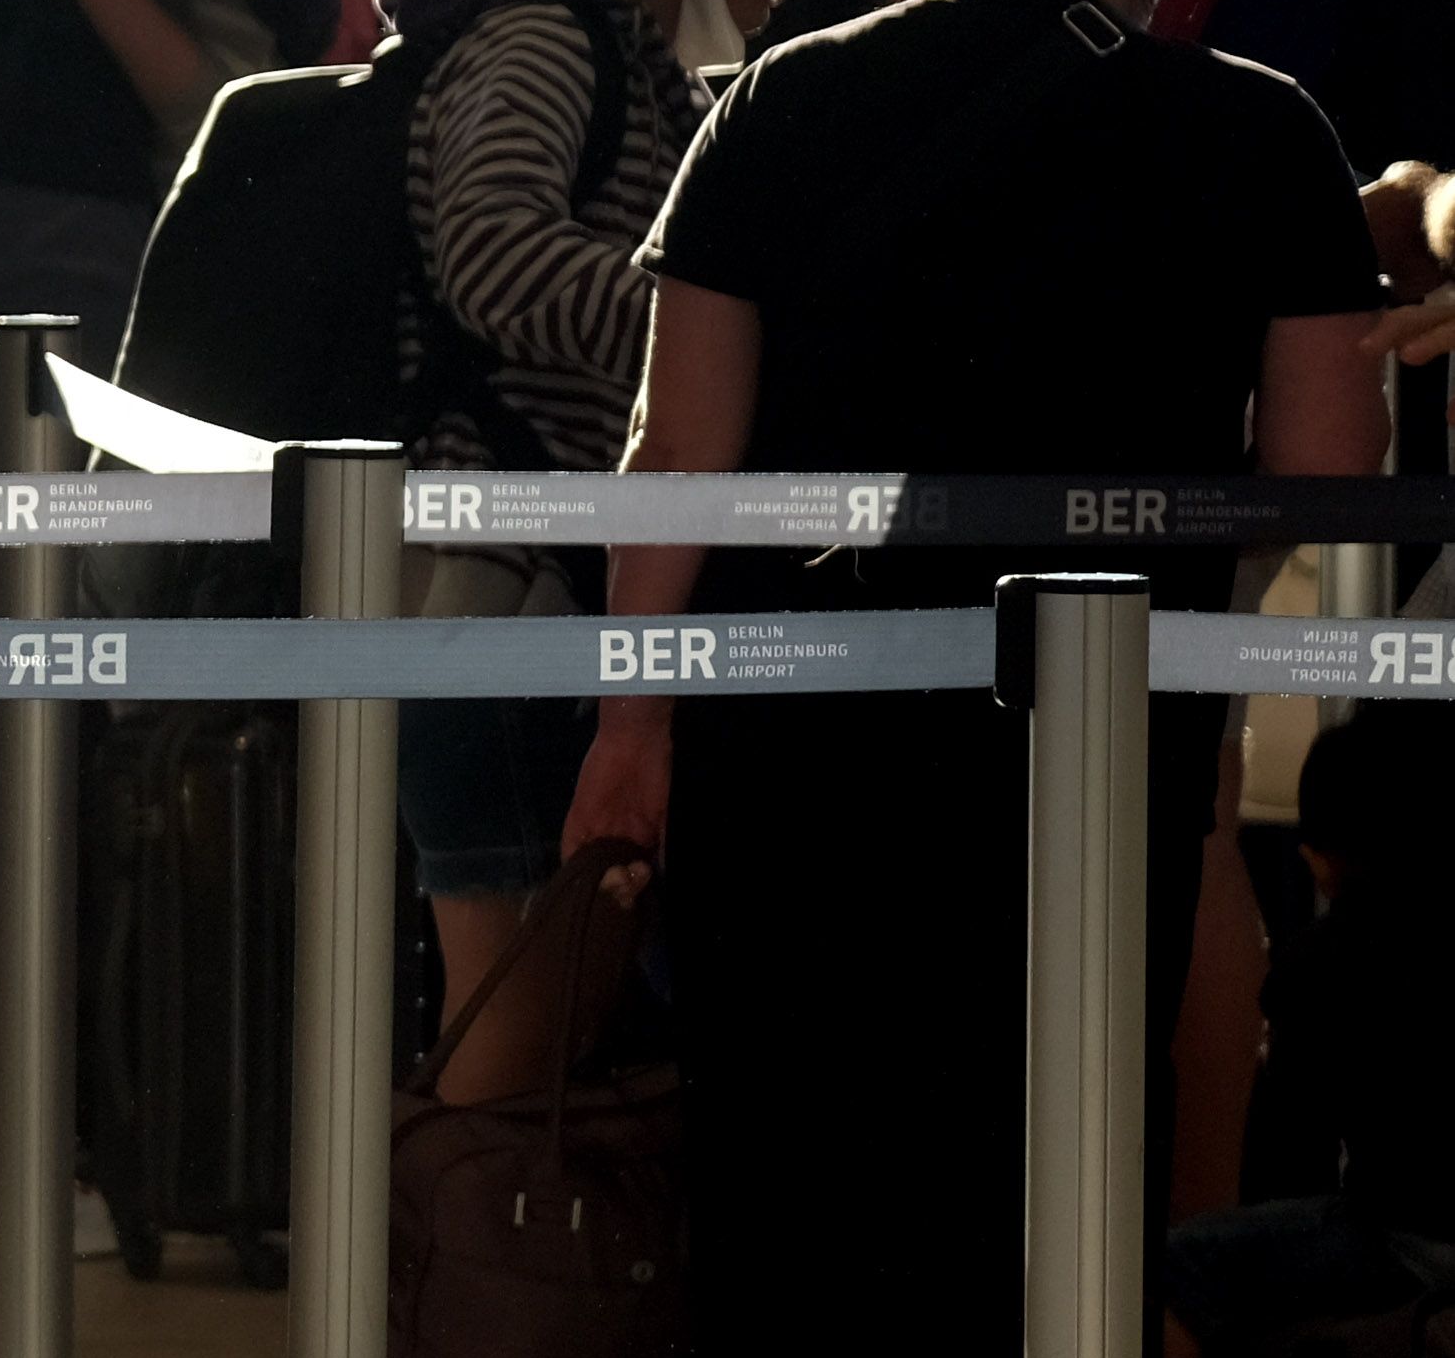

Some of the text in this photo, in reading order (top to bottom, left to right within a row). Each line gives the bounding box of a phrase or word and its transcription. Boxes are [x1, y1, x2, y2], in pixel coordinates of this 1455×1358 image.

[50, 483, 98, 496] BERLIN
[492, 484, 541, 497] BERLIN
[1177, 488, 1226, 500] BERLIN
[49, 499, 154, 514] BRANDENBURG
[492, 500, 596, 514] BRANDENBURG
[1065, 487, 1168, 535] BER
[1177, 505, 1282, 518] BRANDENBURG
[48, 516, 109, 530] AIRPORT
[491, 517, 550, 530] AIRPORT
[1175, 521, 1235, 534] AIRPORT
[727, 625, 784, 640] BERLIN
[598, 627, 717, 682] BER
[728, 643, 849, 659] BRANDENBURG
[727, 663, 796, 679] AIRPORT
